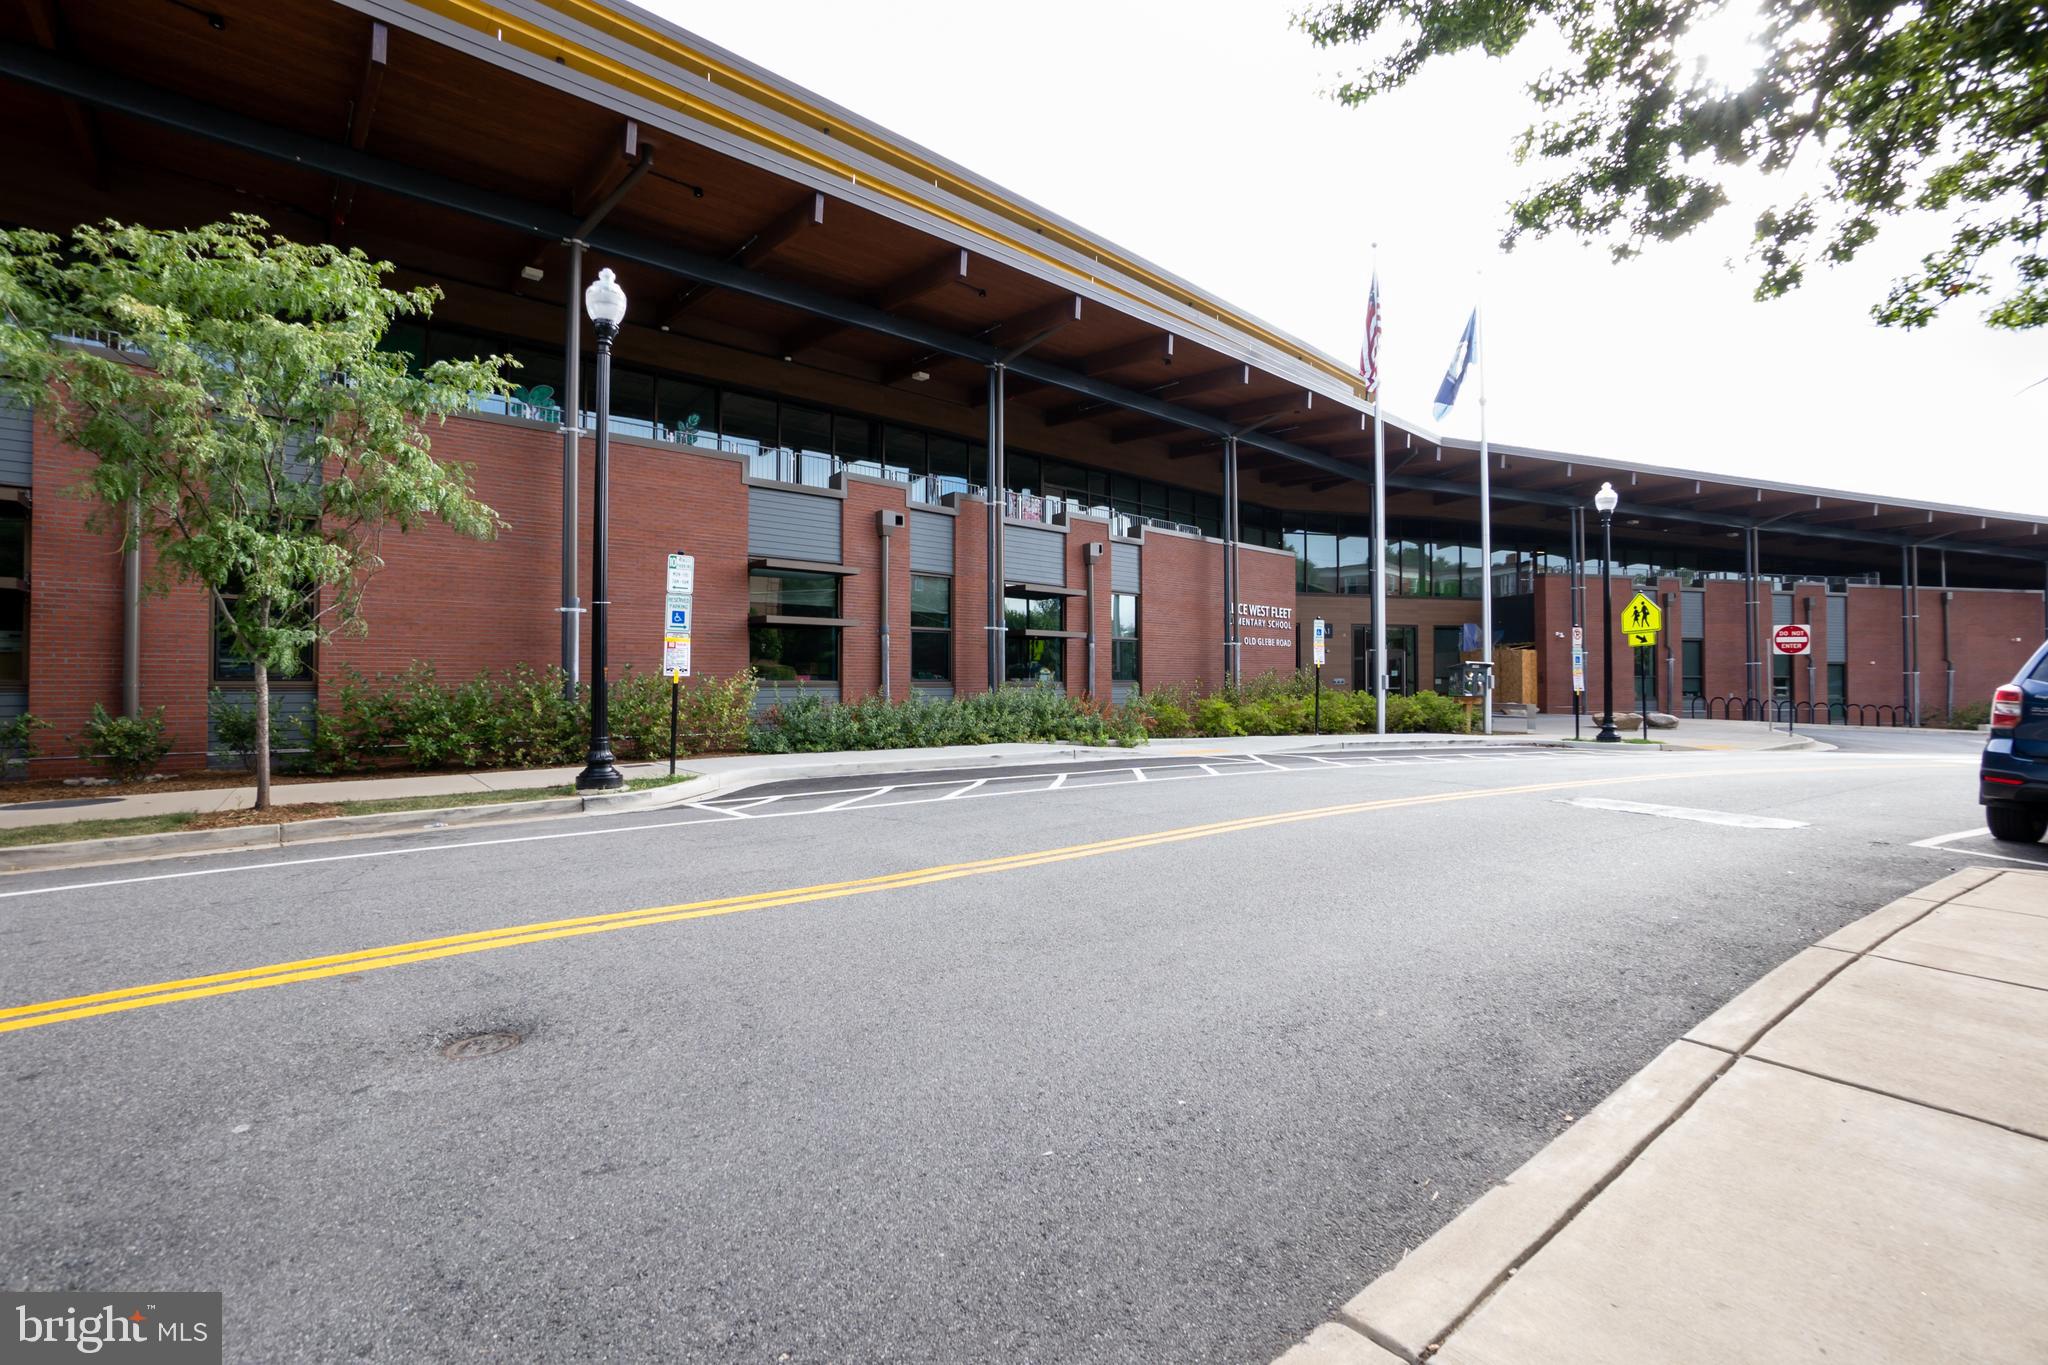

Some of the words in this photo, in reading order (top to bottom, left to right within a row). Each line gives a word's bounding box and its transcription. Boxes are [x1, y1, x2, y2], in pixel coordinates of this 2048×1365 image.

[1249, 604, 1270, 617] WEST
[1271, 606, 1292, 619] FLEET
[1267, 620, 1292, 629] SCHOOL
[1244, 636, 1256, 646] OLD
[1257, 638, 1275, 647] GLEBE
[1276, 639, 1292, 648] ROAD
